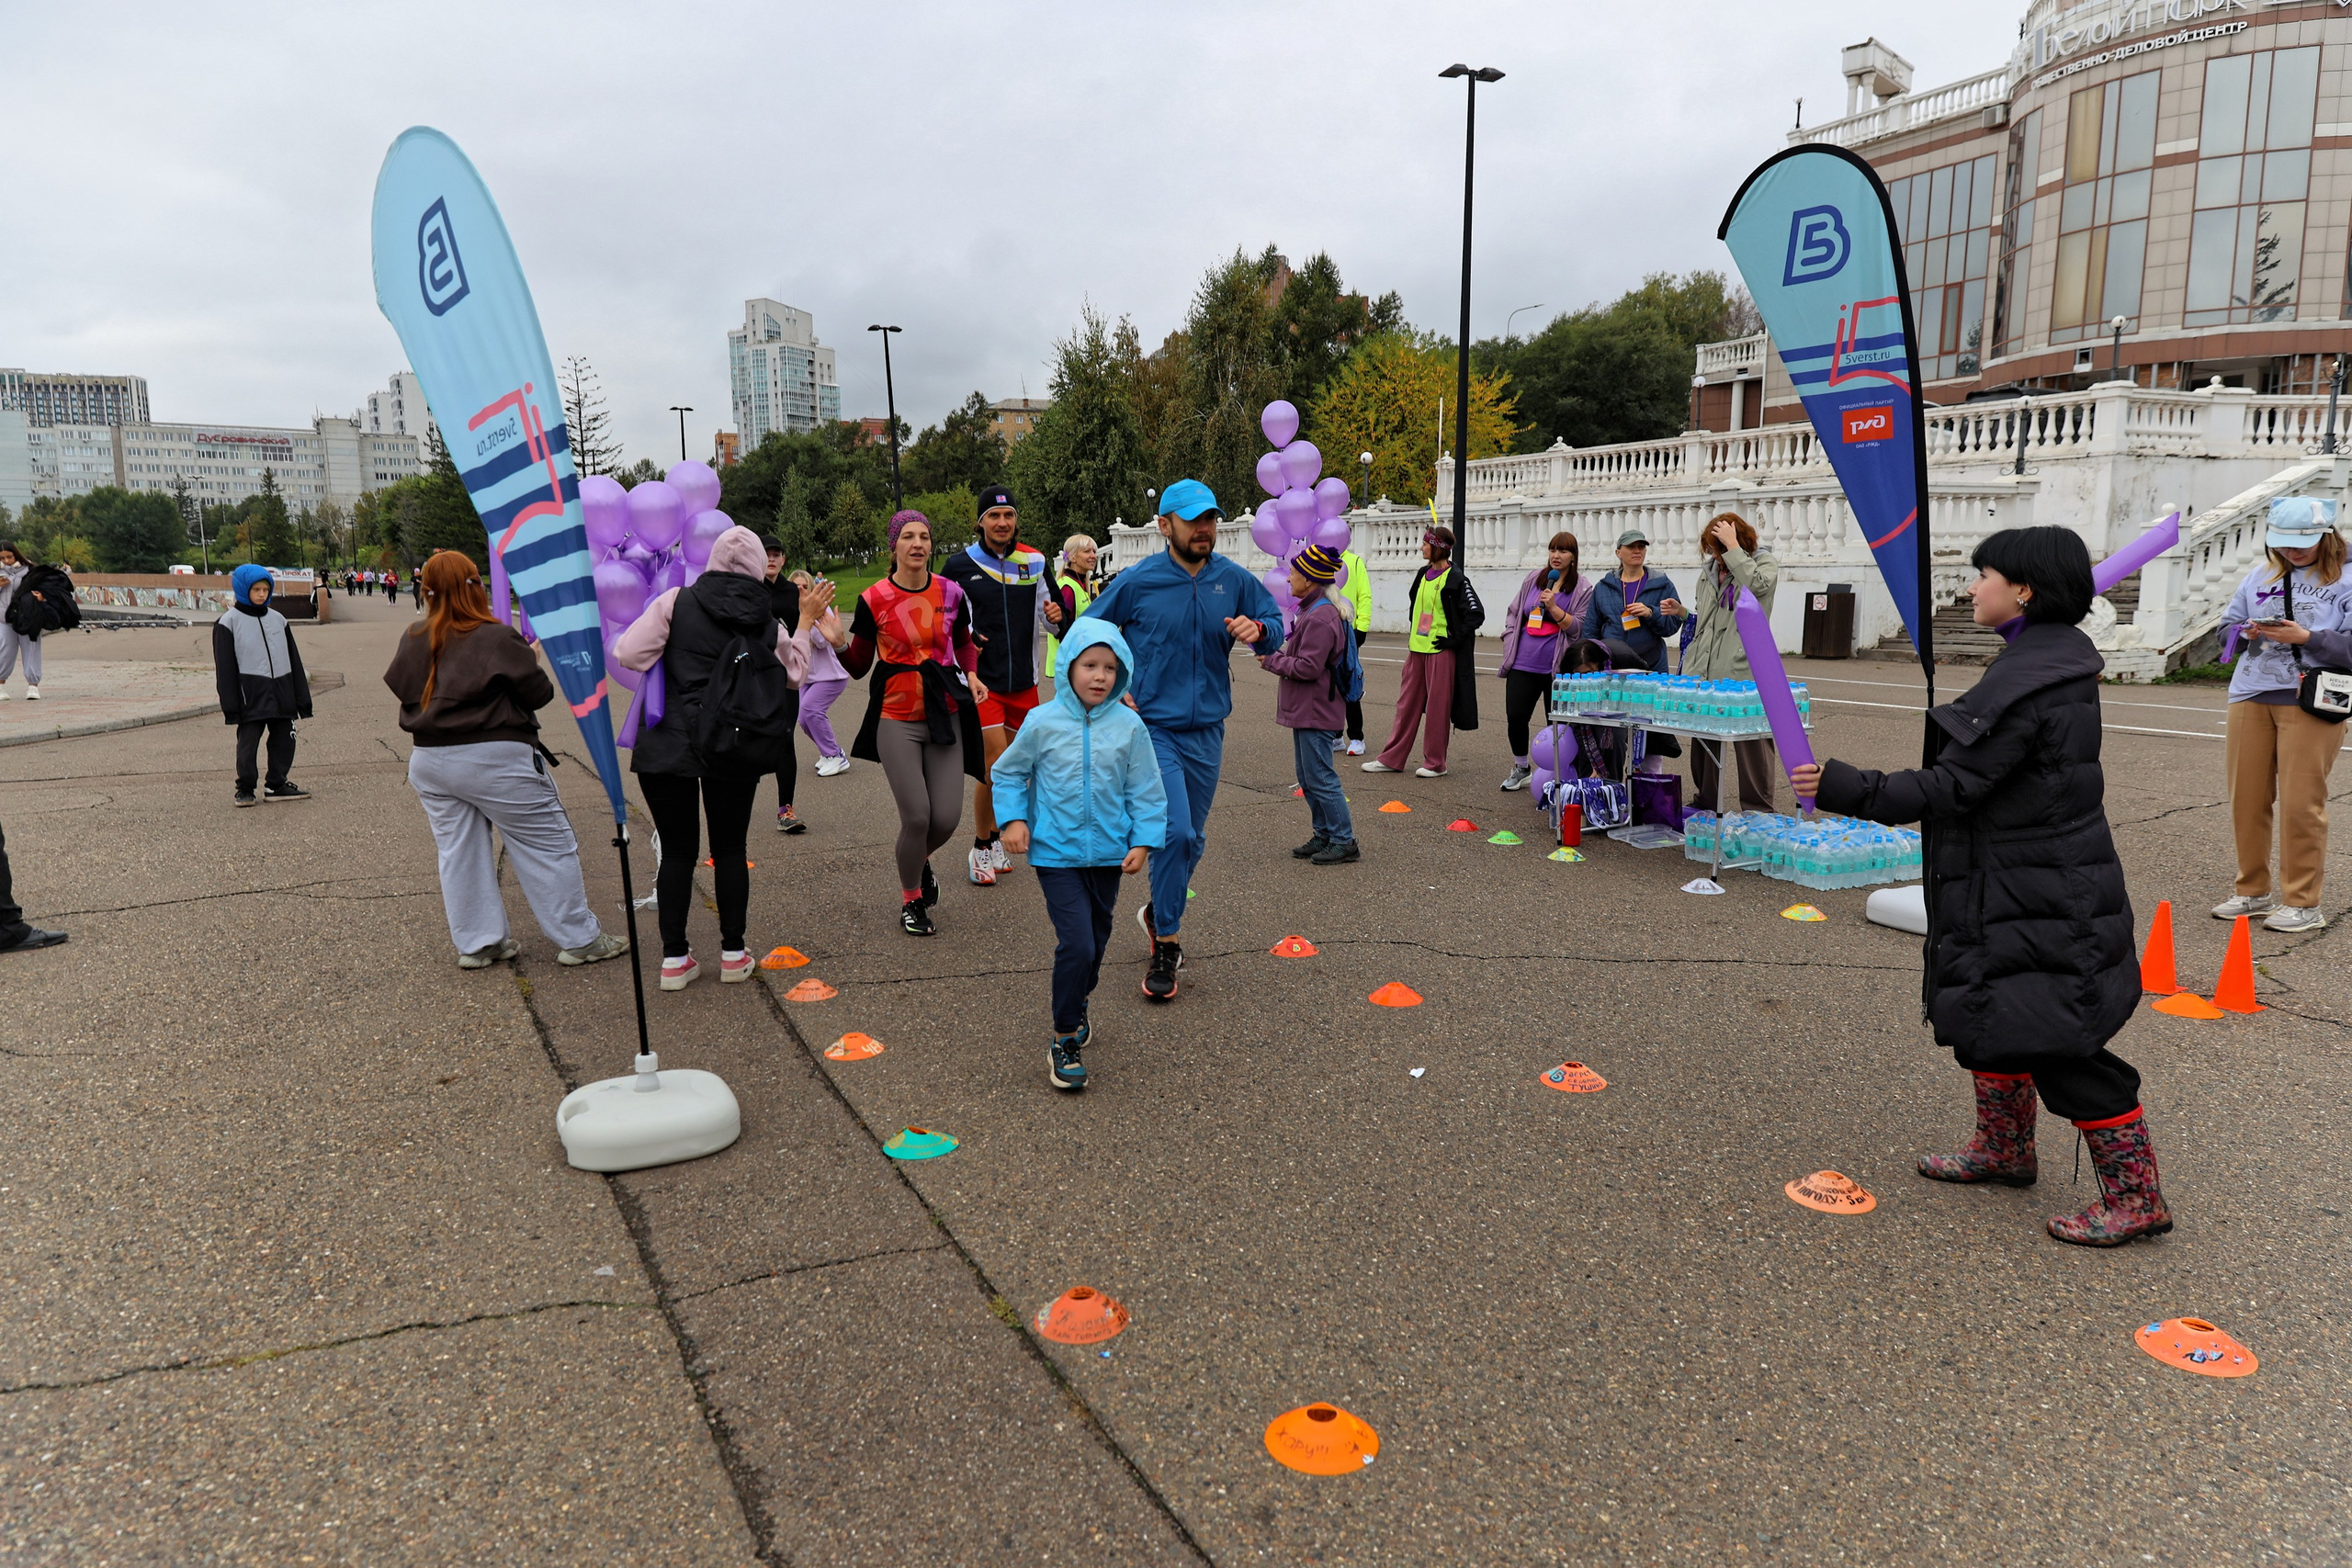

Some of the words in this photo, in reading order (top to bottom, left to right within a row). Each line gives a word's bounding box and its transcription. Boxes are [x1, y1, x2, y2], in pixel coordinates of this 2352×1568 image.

[2030, 28, 2189, 90] ОБЩЕСТВЕННО-ДЕЛОВОЙ
[2192, 21, 2248, 42] ЦЕНТР
[1845, 350, 1891, 365] 5verst.ru
[1838, 400, 1874, 411] ОФИЦИАЛЬНЫЙ
